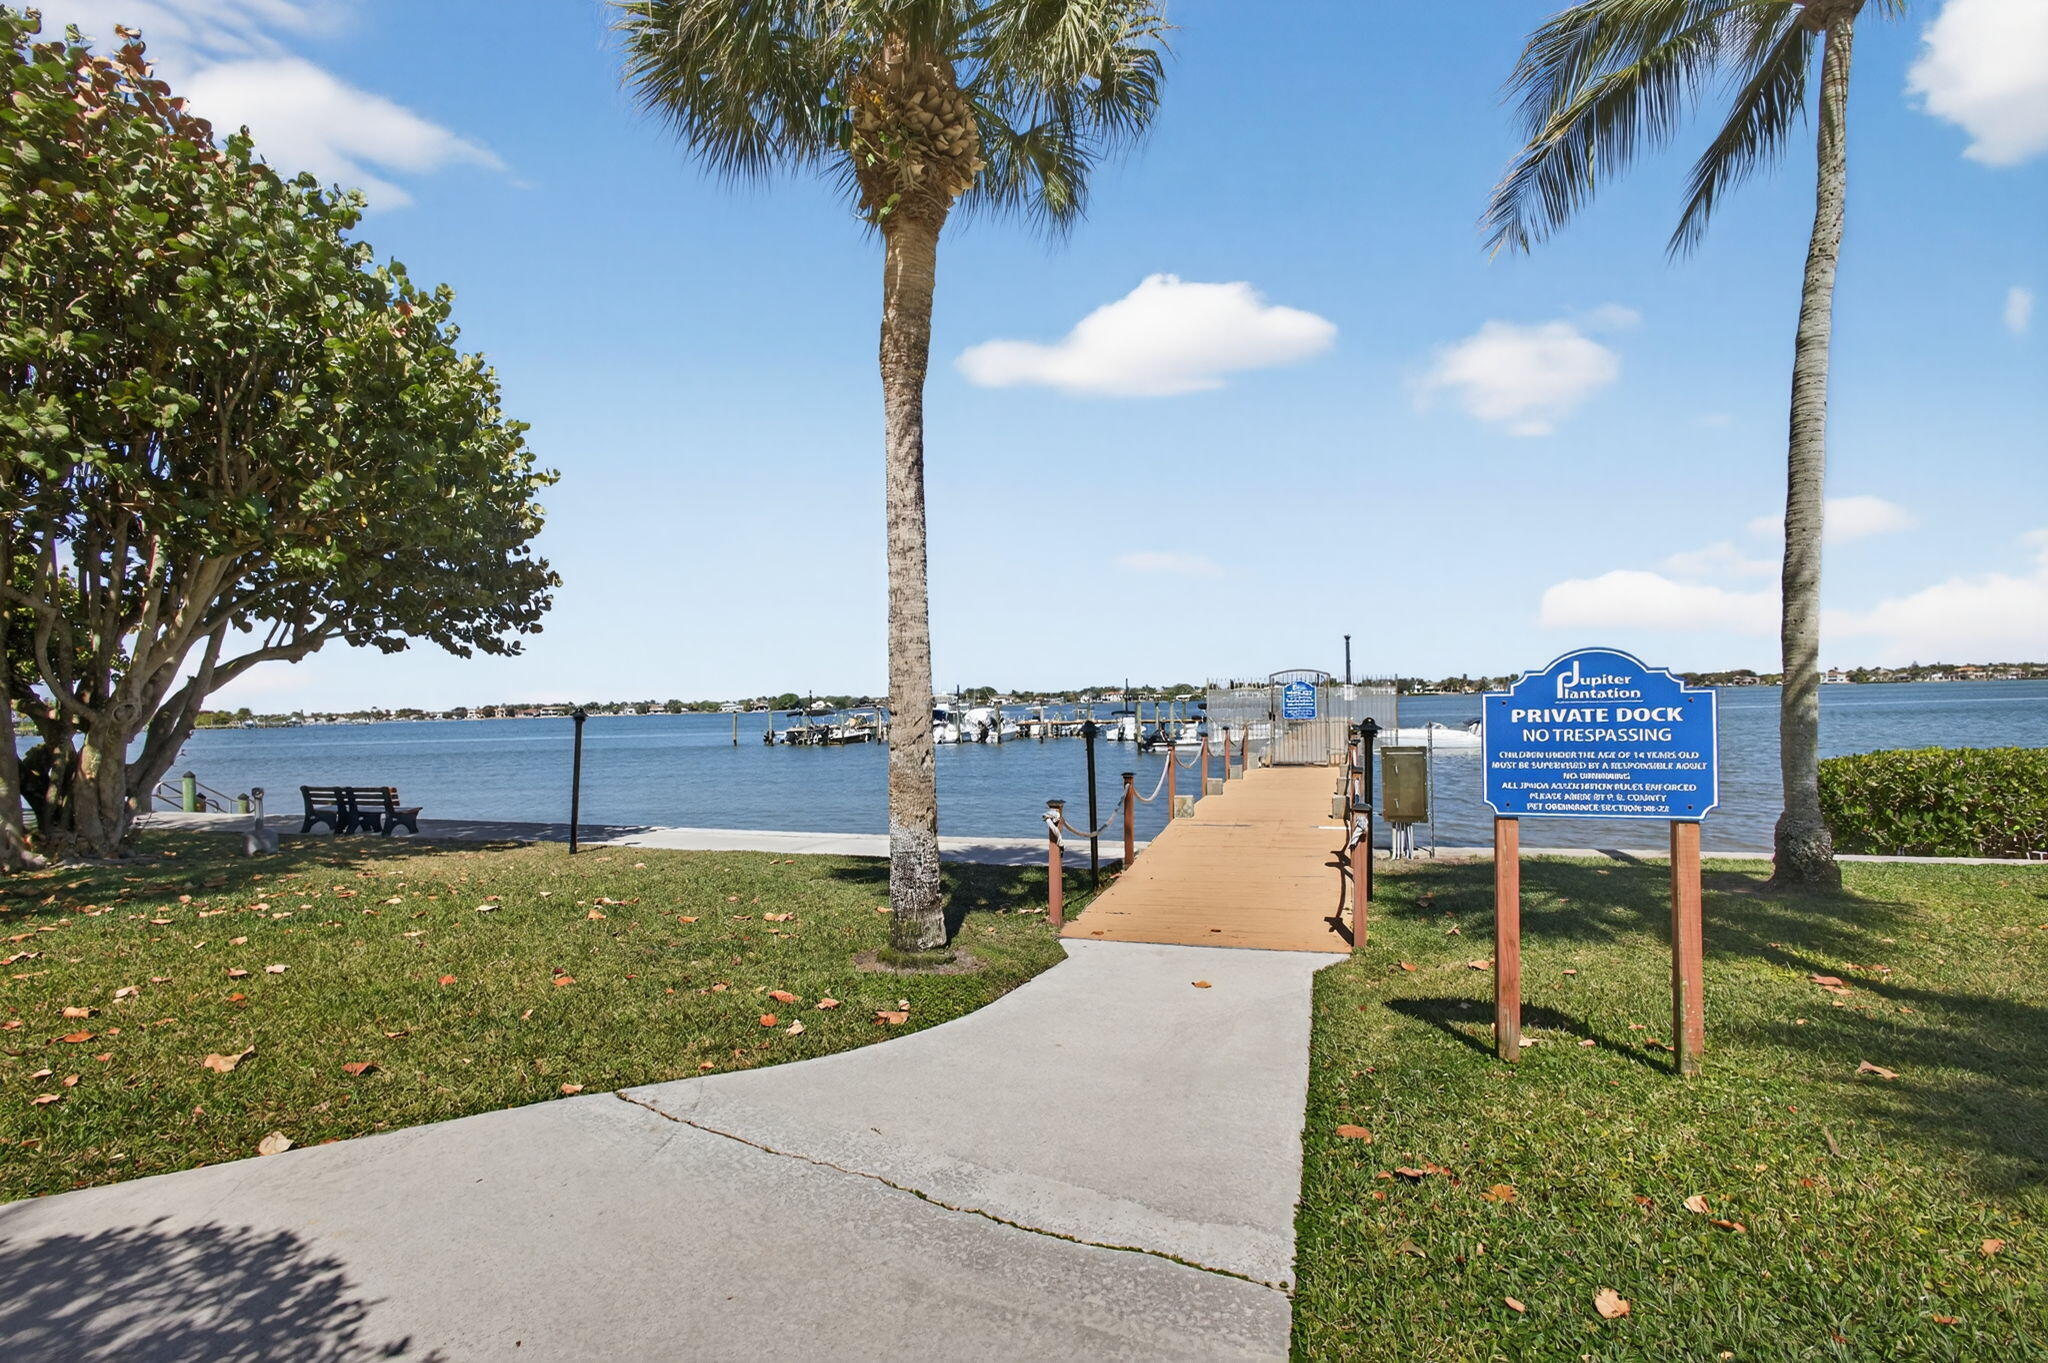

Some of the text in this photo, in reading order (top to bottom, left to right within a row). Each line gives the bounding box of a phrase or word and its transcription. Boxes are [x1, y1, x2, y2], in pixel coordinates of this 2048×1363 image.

[1563, 660, 1632, 687] Jupiter
[1556, 671, 1641, 699] Plantation
[1511, 706, 1683, 723] PRIVATE DOCK
[1522, 728, 1672, 742] NO TRESPASSING
[1499, 751, 1544, 759] CHILDREN
[1545, 751, 1577, 759] UNDER
[1578, 751, 1596, 759] THE
[1597, 751, 1616, 759] AGE
[1618, 751, 1631, 759] OF
[1646, 751, 1677, 759] YEARS
[1678, 751, 1700, 759] OLD
[1675, 762, 1708, 770] ADULT
[1614, 783, 1644, 791] RULES
[1645, 783, 1697, 791] ENFORCED
[1627, 794, 1667, 802] COUNTY
